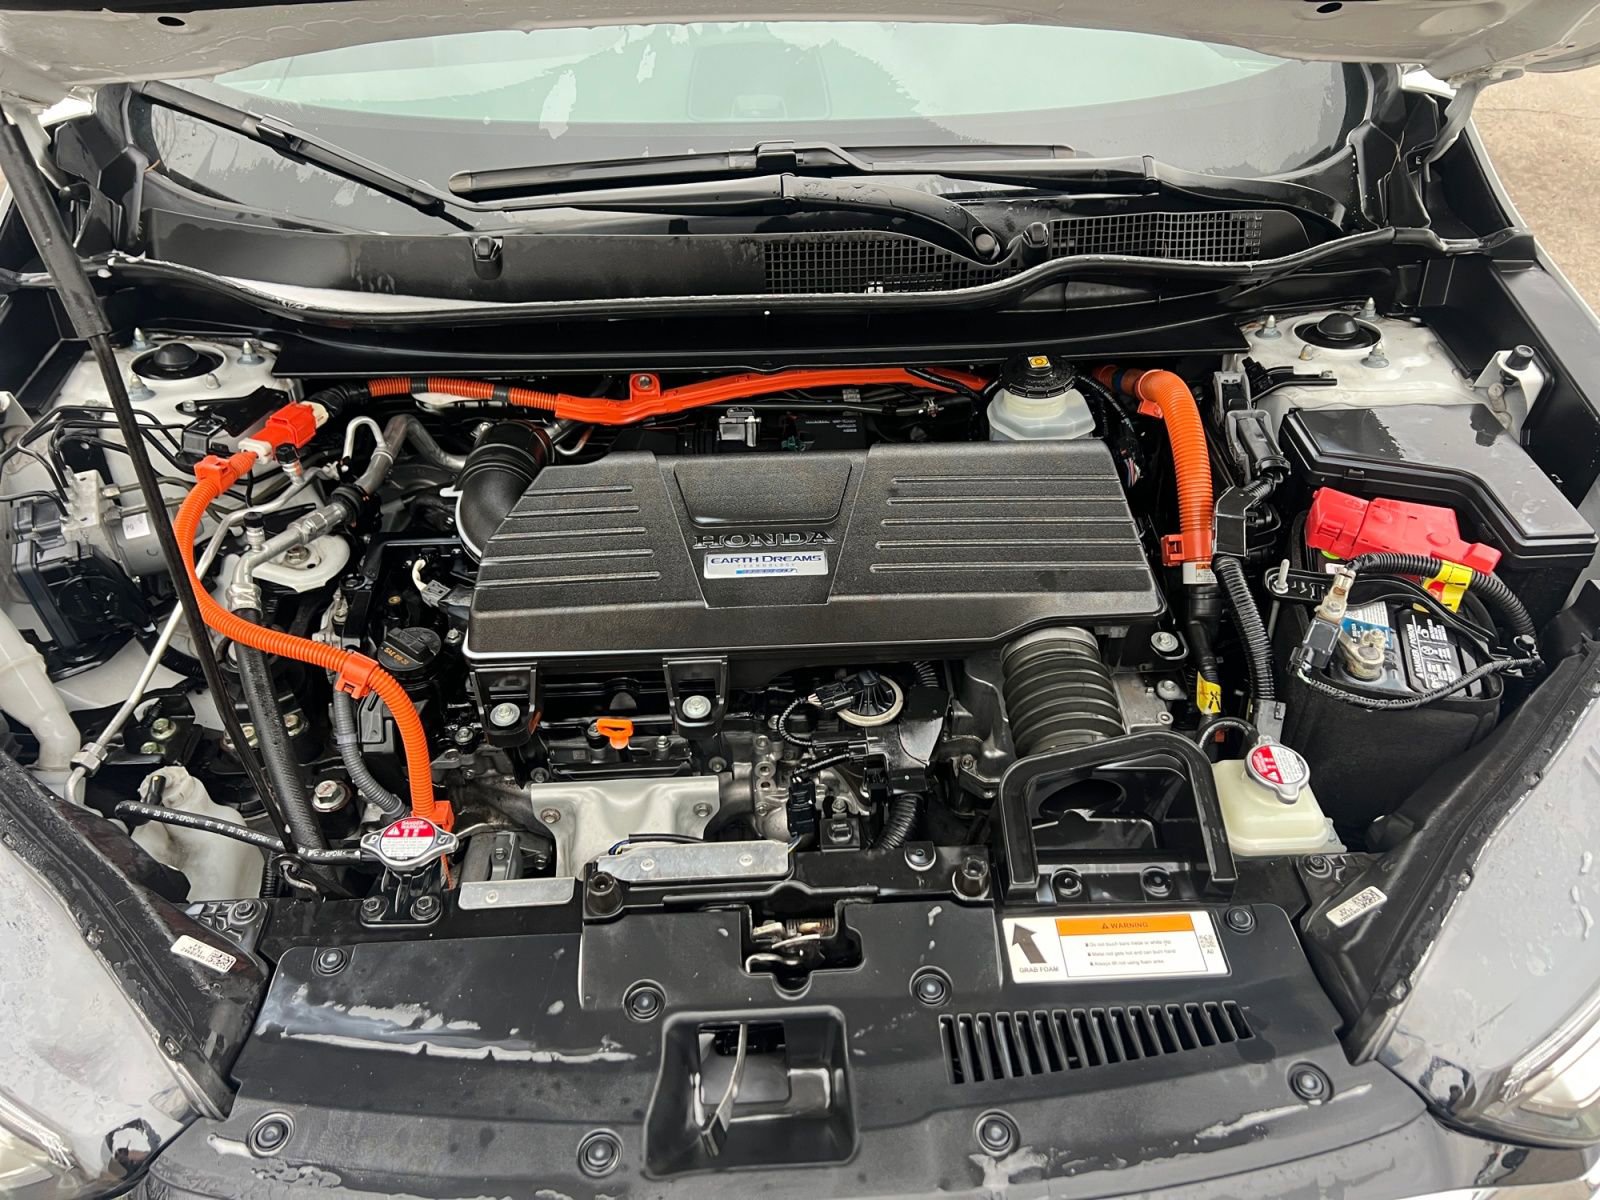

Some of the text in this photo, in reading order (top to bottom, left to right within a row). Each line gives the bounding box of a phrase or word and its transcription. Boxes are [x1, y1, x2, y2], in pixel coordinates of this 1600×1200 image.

[693, 531, 837, 549] HONDA
[711, 554, 821, 564] EARTH DREAMS
[162, 811, 174, 820] TPC
[1111, 921, 1149, 929] WARNING
